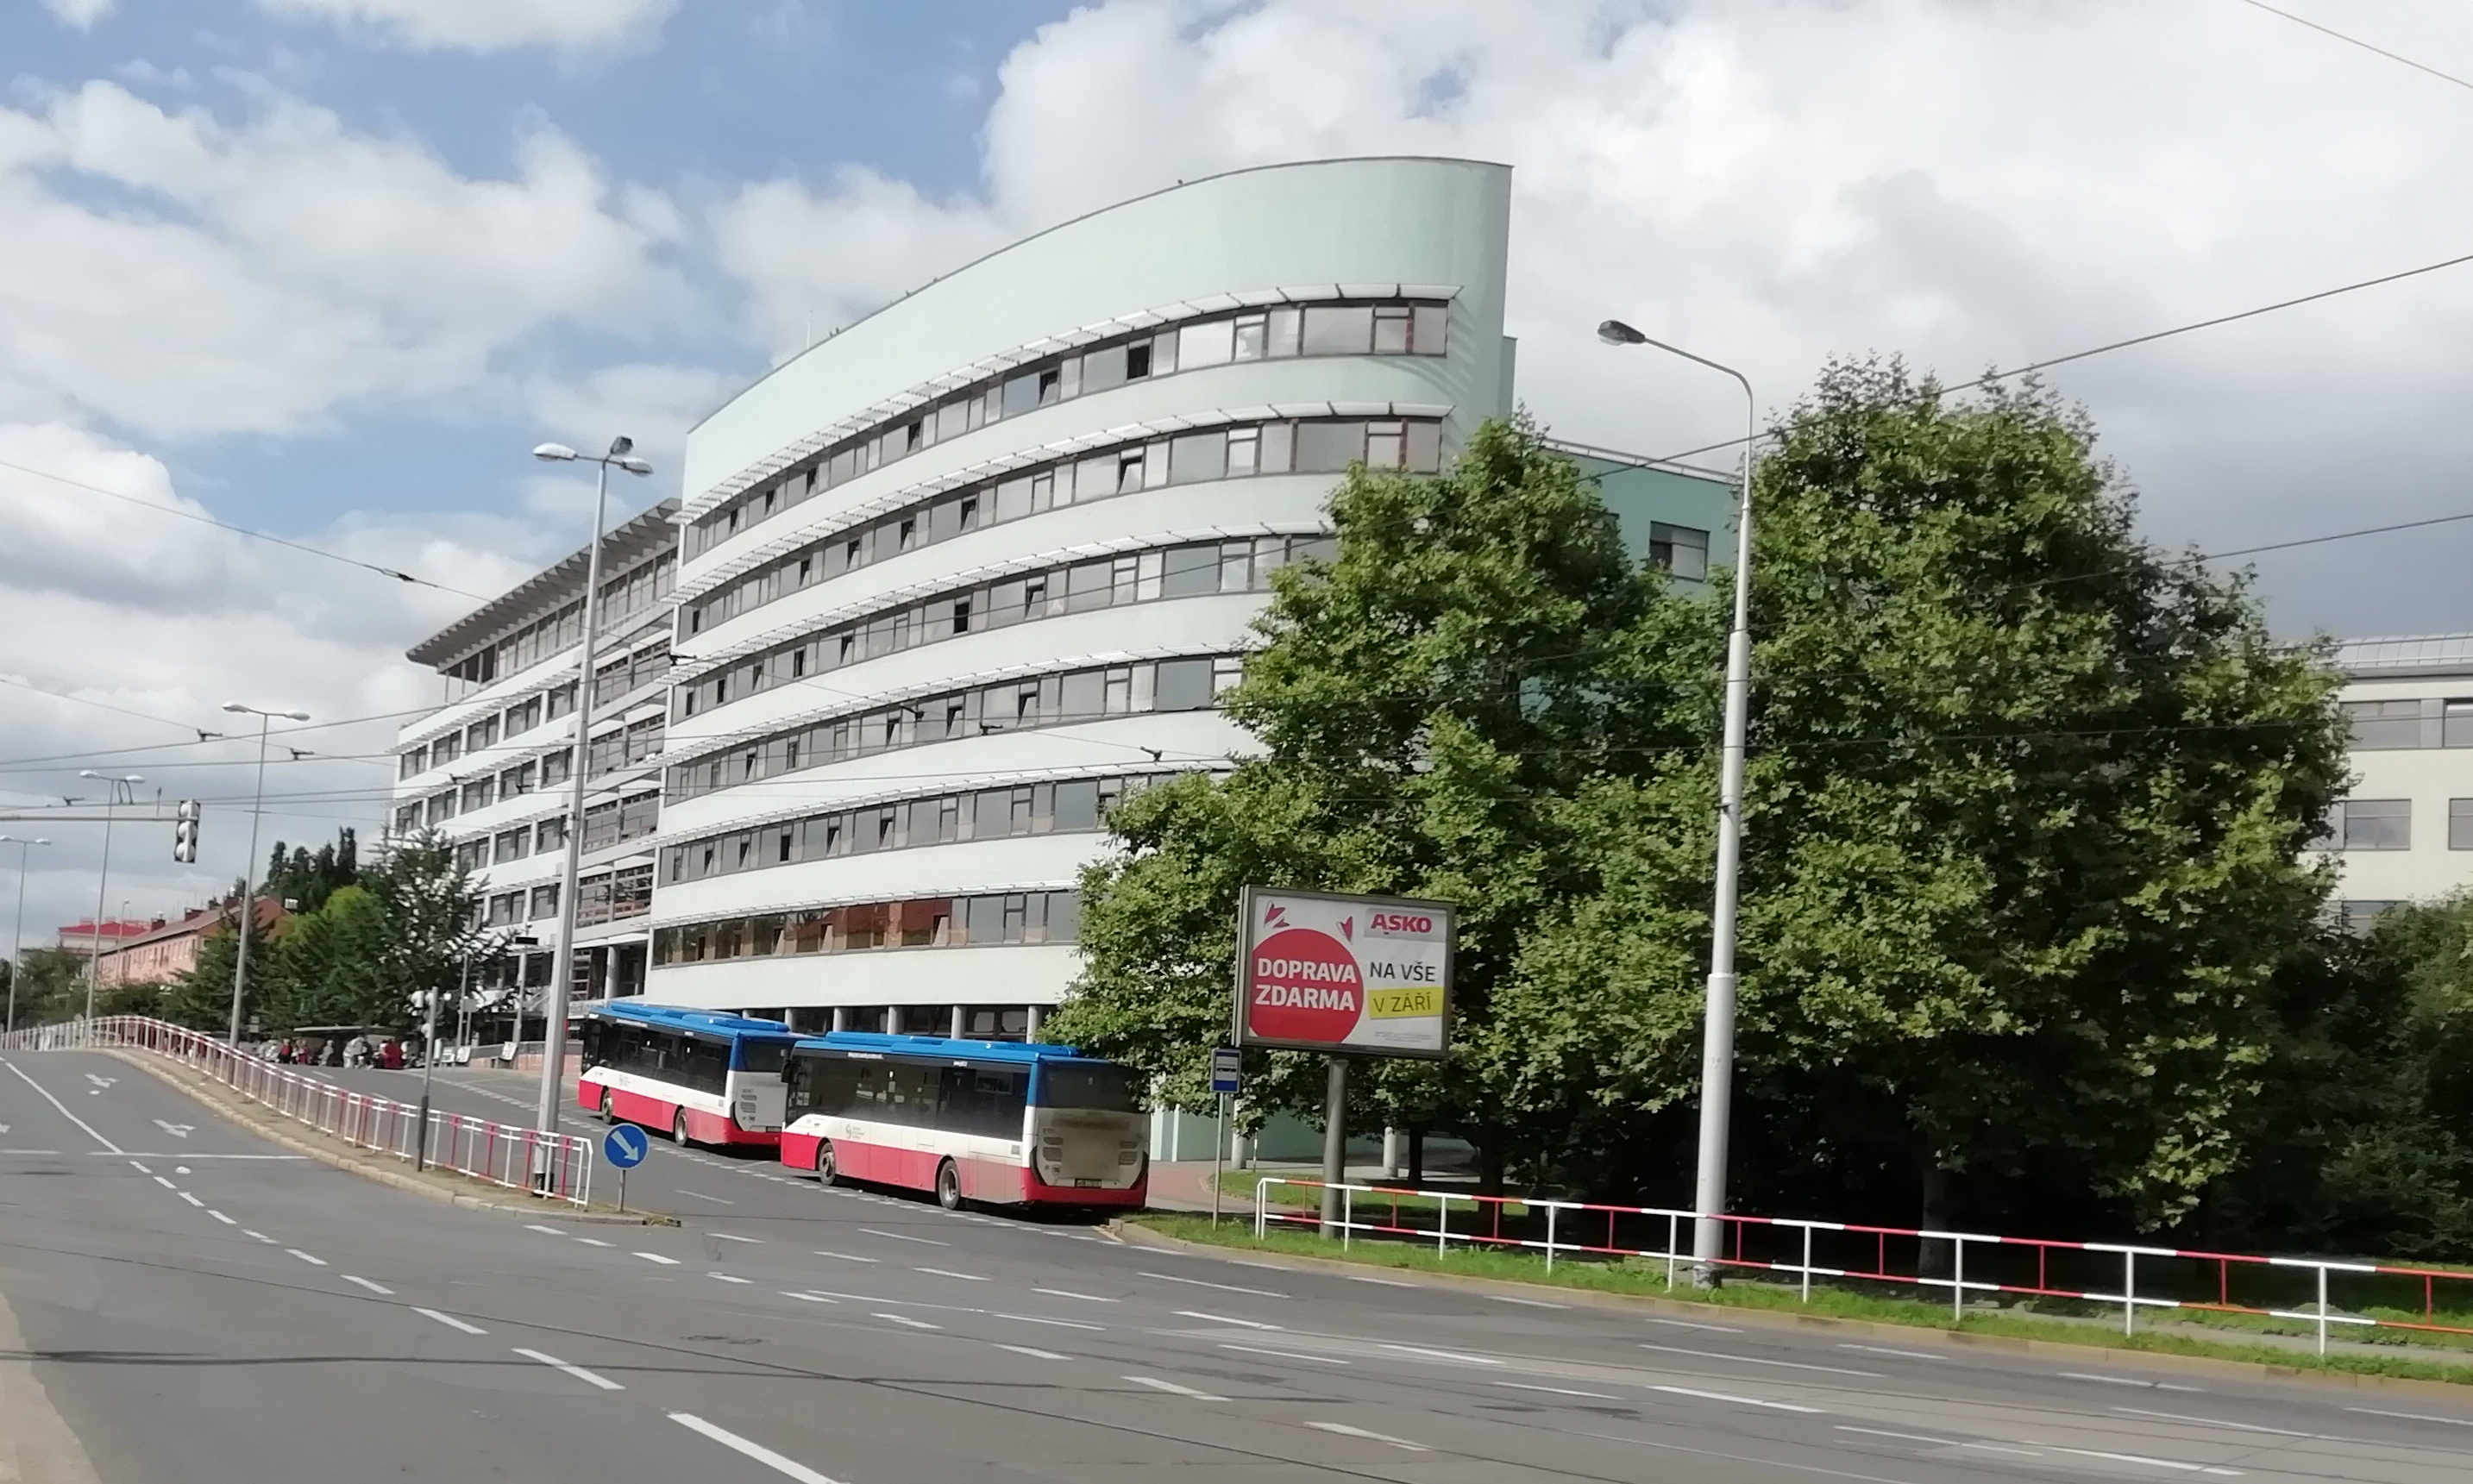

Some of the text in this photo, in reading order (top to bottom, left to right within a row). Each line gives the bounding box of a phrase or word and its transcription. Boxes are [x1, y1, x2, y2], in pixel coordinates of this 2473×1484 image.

[1370, 913, 1433, 934] ASKO
[1257, 957, 1357, 984] DOPRAVA
[1370, 961, 1436, 982] NA VŠE
[1255, 984, 1356, 1011] ZDARMA
[1372, 991, 1432, 1013] V ZÁŘÍ
